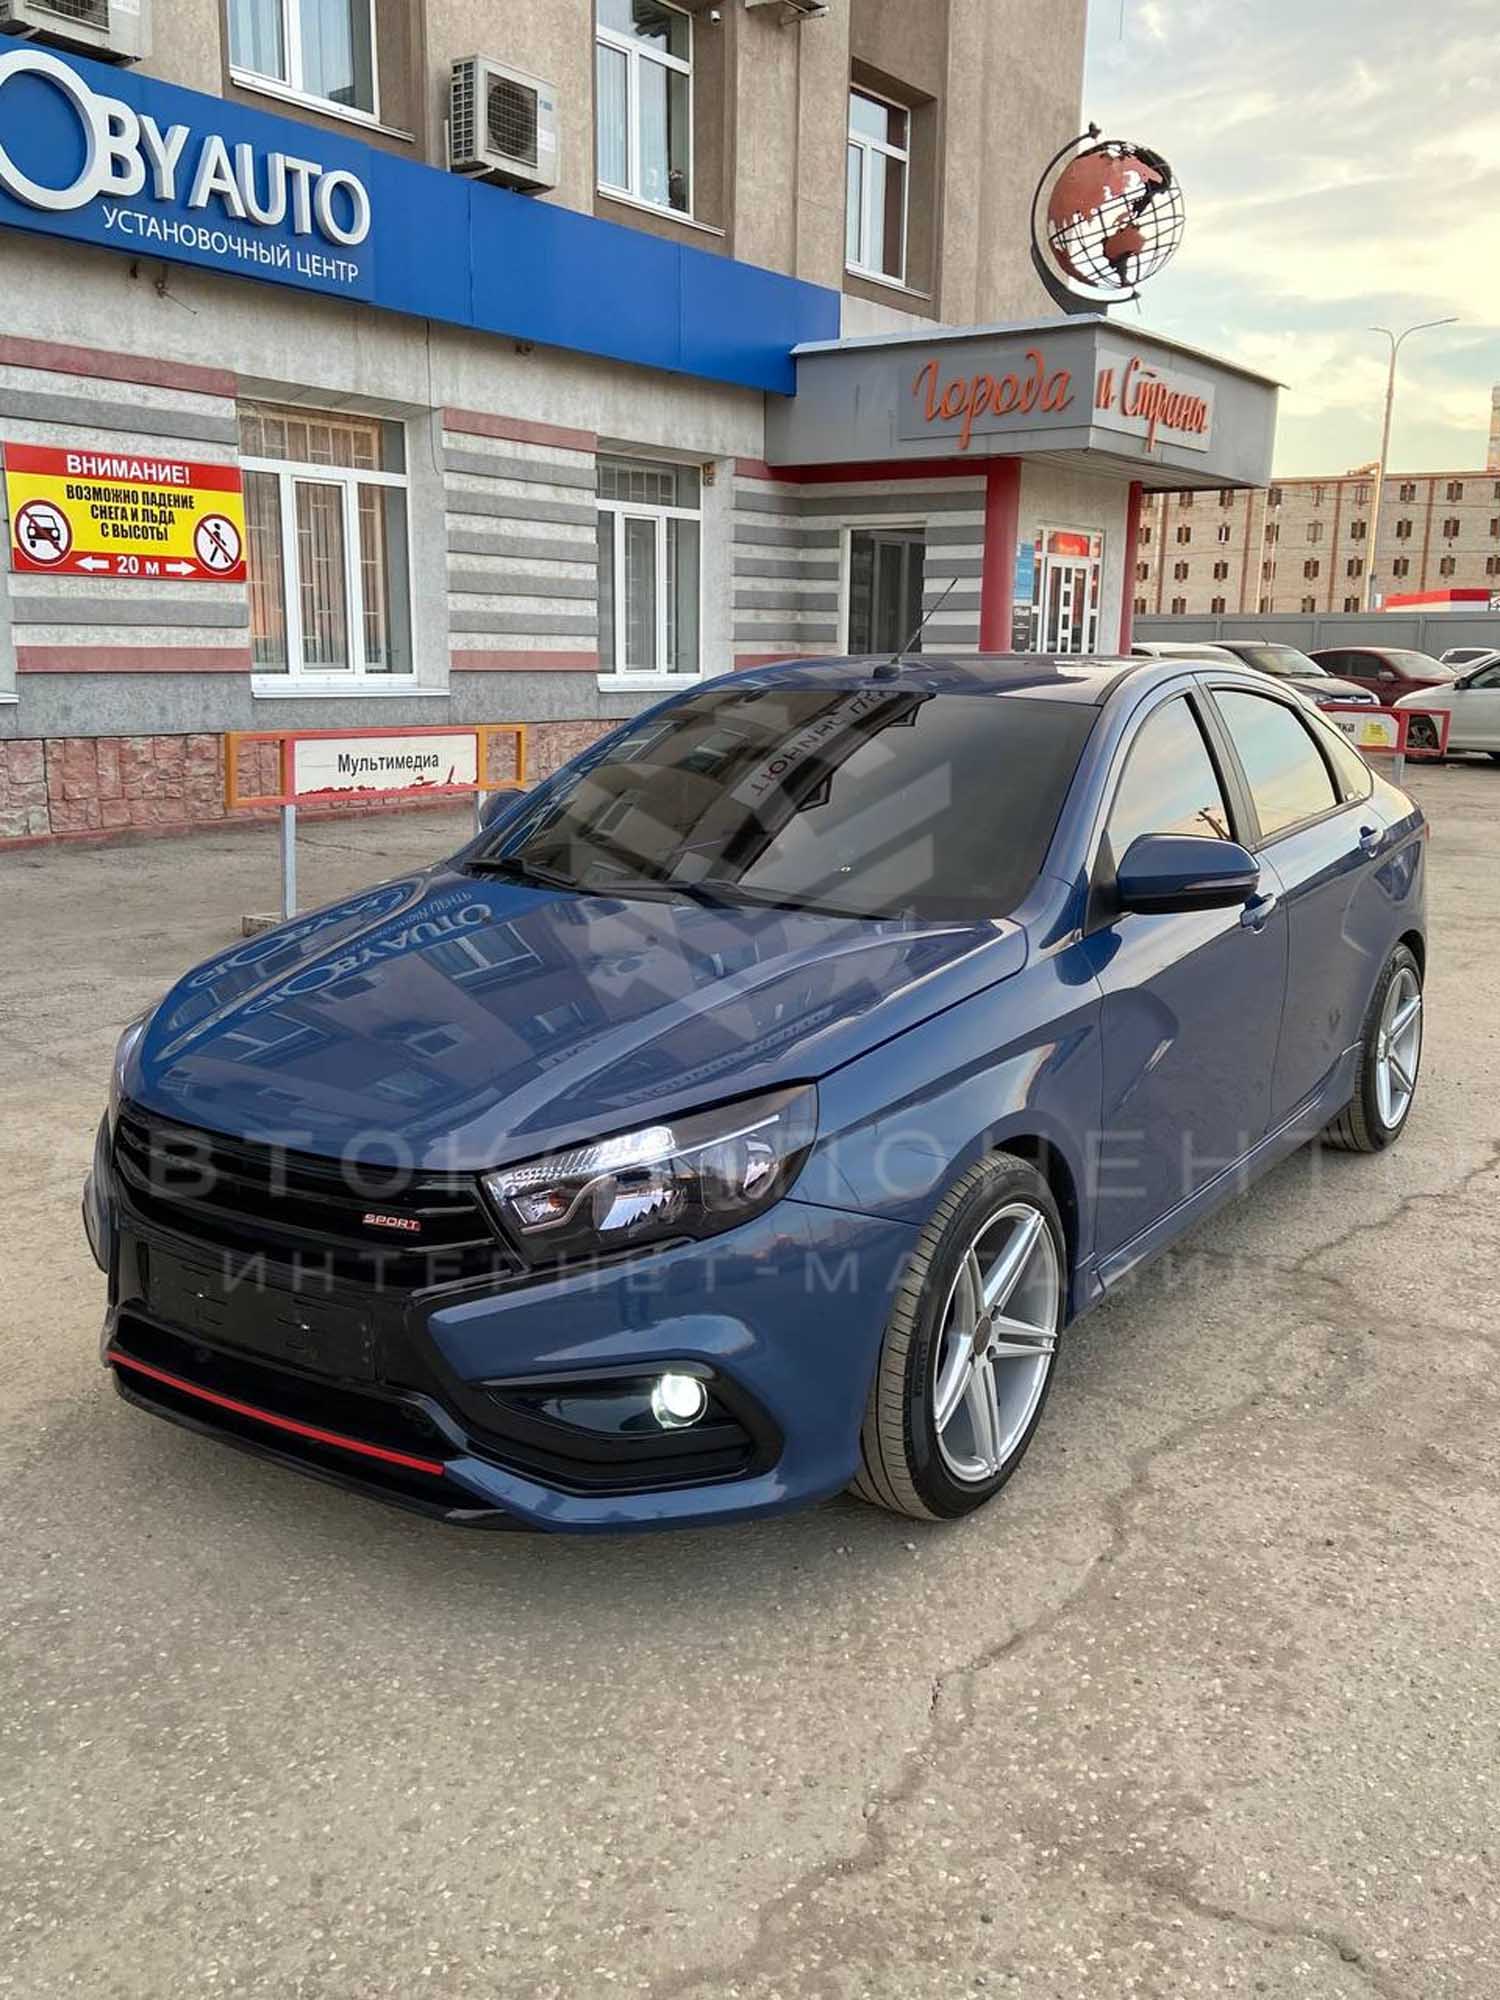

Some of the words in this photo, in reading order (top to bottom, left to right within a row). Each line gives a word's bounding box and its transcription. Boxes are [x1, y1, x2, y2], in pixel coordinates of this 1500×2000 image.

[102, 205, 291, 270] УСТАНОВОЧНЫЙ
[297, 255, 359, 284] ЦЕНТР
[912, 347, 1075, 450] Города
[1095, 367, 1116, 410] и
[1121, 355, 1208, 454] Страны
[66, 454, 190, 484] ВНИМАНИЕ!
[66, 484, 139, 504] ВОЗМОЖНО
[141, 491, 195, 510] ПАДЕНИЕ
[90, 504, 129, 521] СНЕГА
[132, 507, 141, 522] И
[141, 508, 175, 525] ЛЬДА
[101, 522, 110, 538] С
[112, 524, 169, 541] ВЫСОТЫ
[117, 556, 139, 574] 20
[337, 752, 440, 776] Мультимедиа
[362, 1213, 421, 1232] SPORT
